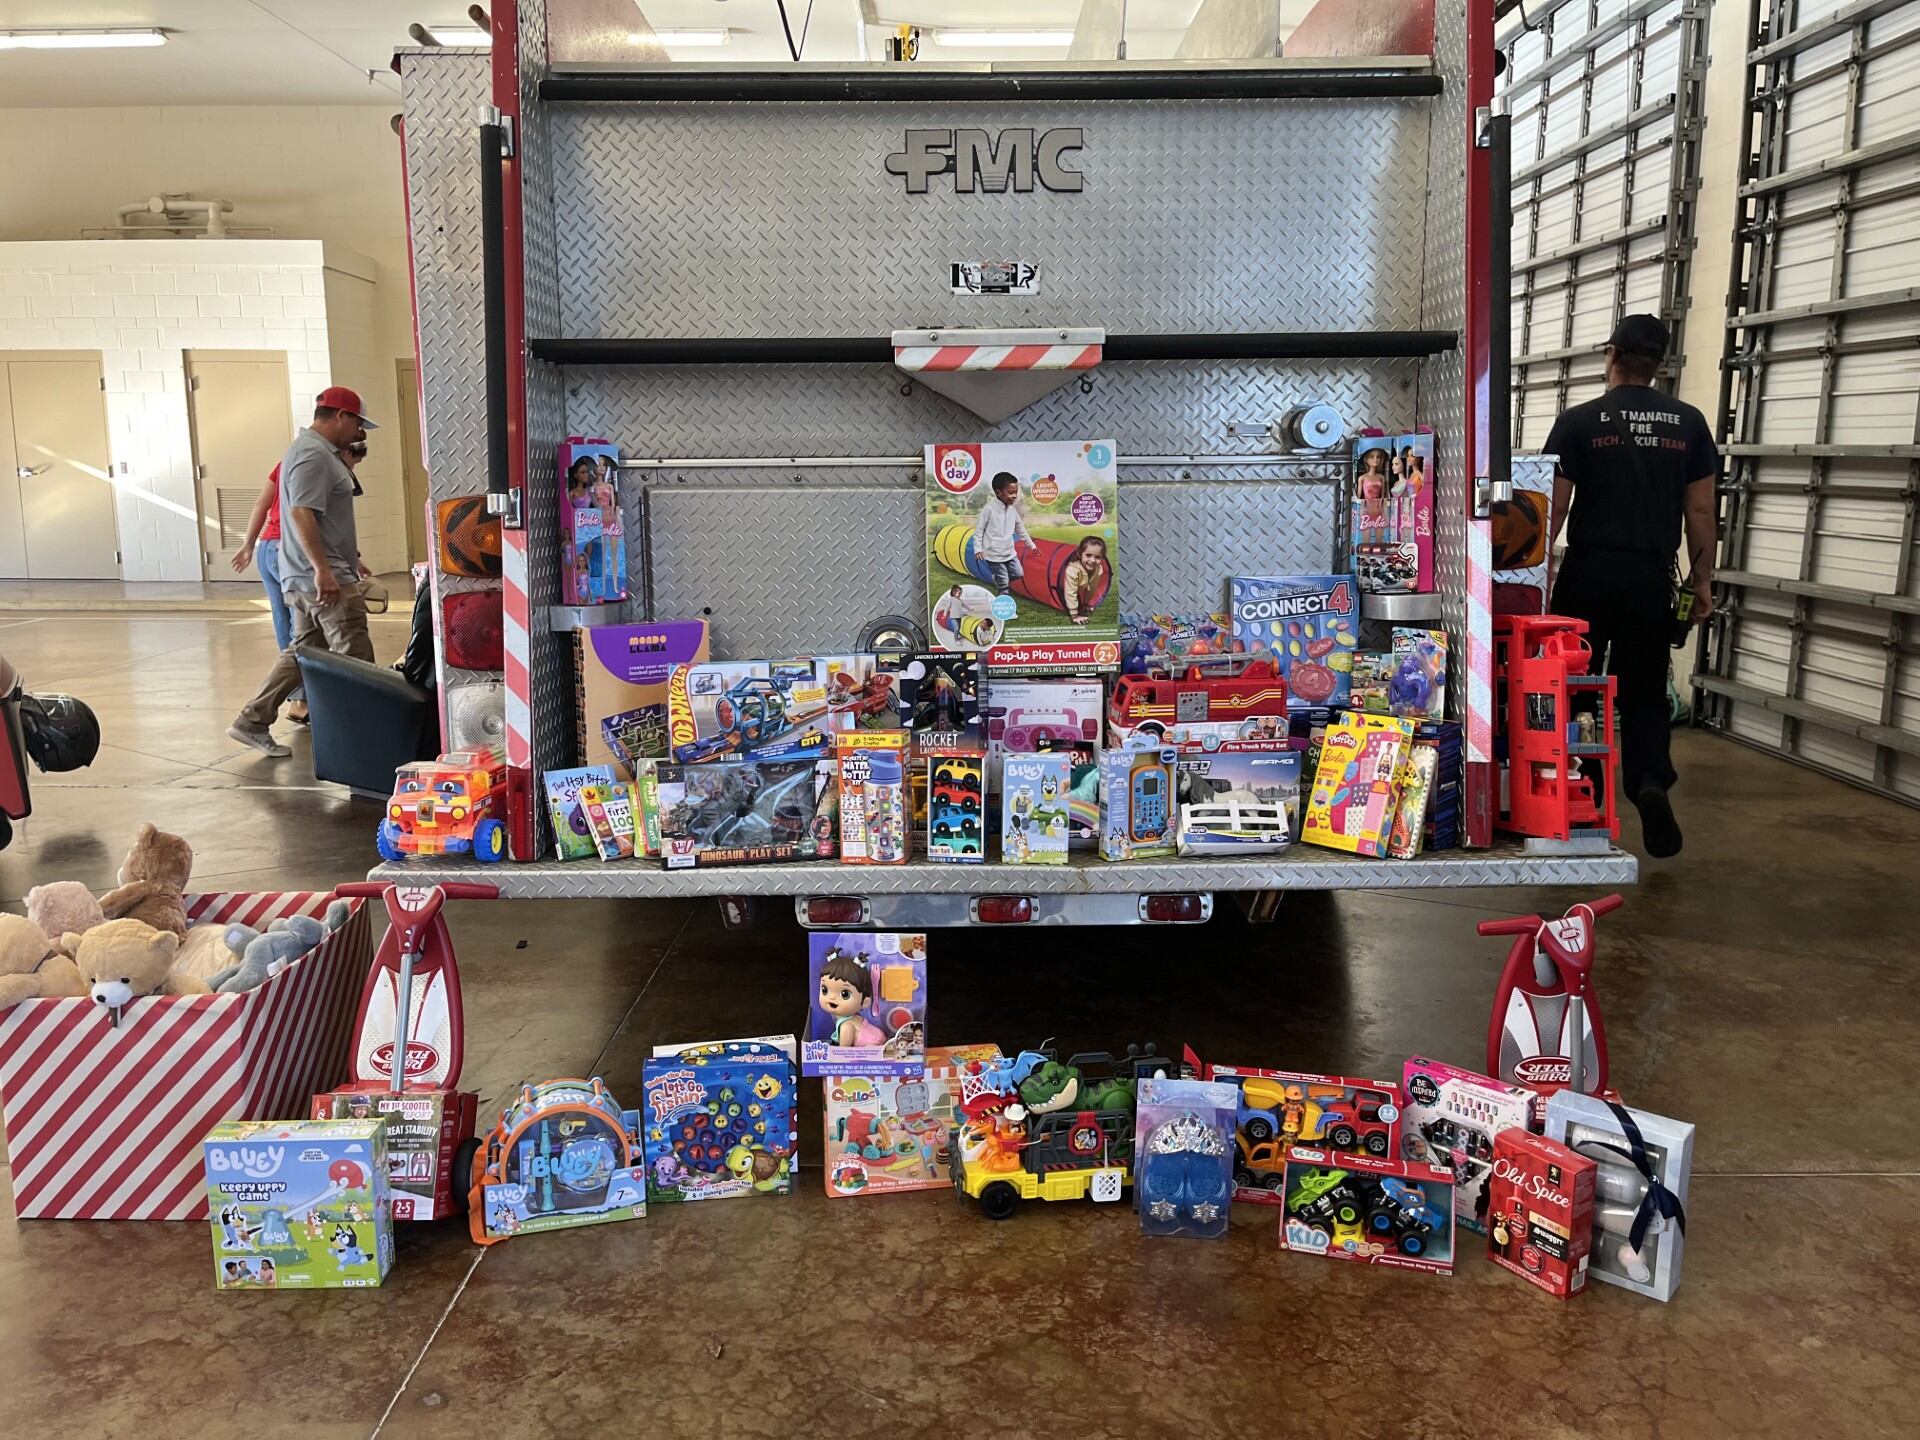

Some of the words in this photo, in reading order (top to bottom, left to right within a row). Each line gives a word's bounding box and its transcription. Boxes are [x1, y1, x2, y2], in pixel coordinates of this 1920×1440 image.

[885, 128, 1083, 194] FMC
[1629, 410, 1681, 425] MANATEE
[1629, 423, 1653, 434] FIRE
[1592, 435, 1619, 448] TECH
[1661, 437, 1687, 449] TEAM
[944, 457, 973, 471] play
[946, 467, 970, 481] day
[577, 512, 601, 528] Barbie
[1360, 514, 1388, 530] Barbie
[1416, 505, 1431, 537] Barbie
[1241, 594, 1330, 621] CONNECT
[1328, 582, 1351, 614] 4
[994, 651, 1030, 662] Pop-Up
[1031, 650, 1054, 663] Play
[1056, 648, 1091, 660] Tunnel
[1098, 650, 1114, 662] 2+
[801, 736, 823, 748] CITY
[919, 733, 959, 747] ROCKET
[1260, 743, 1275, 752] Play
[1110, 752, 1136, 768] Bluey
[1322, 749, 1347, 764] Barbie
[842, 761, 869, 771] WATER
[1007, 763, 1046, 781] Bluey
[565, 775, 584, 788] Itsy
[586, 772, 610, 786] Bitsy
[842, 770, 871, 781] BOTTLE
[607, 806, 630, 817] first
[611, 815, 634, 829] 100
[700, 850, 745, 862] DINOSAUR
[750, 847, 772, 860] PLAY
[776, 846, 791, 857] SET
[805, 1040, 829, 1053] baby
[806, 1051, 829, 1061] alive
[645, 1077, 667, 1089] Under
[667, 1070, 681, 1080] the
[681, 1070, 695, 1079] Sea
[1416, 1078, 1427, 1089] BE
[664, 1079, 686, 1098] Let's
[687, 1081, 703, 1093] Go
[380, 1102, 391, 1110] MY
[391, 1101, 400, 1109] 1ST
[401, 1101, 431, 1111] SCOOTER
[404, 1110, 433, 1120] SPORT
[387, 1125, 404, 1136] REAT
[405, 1124, 438, 1137] STABILITY
[1294, 1149, 1323, 1159] KID
[209, 1145, 285, 1178] Bluey
[220, 1183, 256, 1193] Keepy
[257, 1182, 287, 1193] Uppy
[1493, 1158, 1525, 1187] Old
[1525, 1175, 1571, 1208] Spice
[238, 1191, 270, 1201] Game
[487, 1184, 529, 1204] Bluey
[617, 1190, 625, 1201] 7
[396, 1201, 412, 1213] 2-5
[1287, 1225, 1329, 1248] KID
